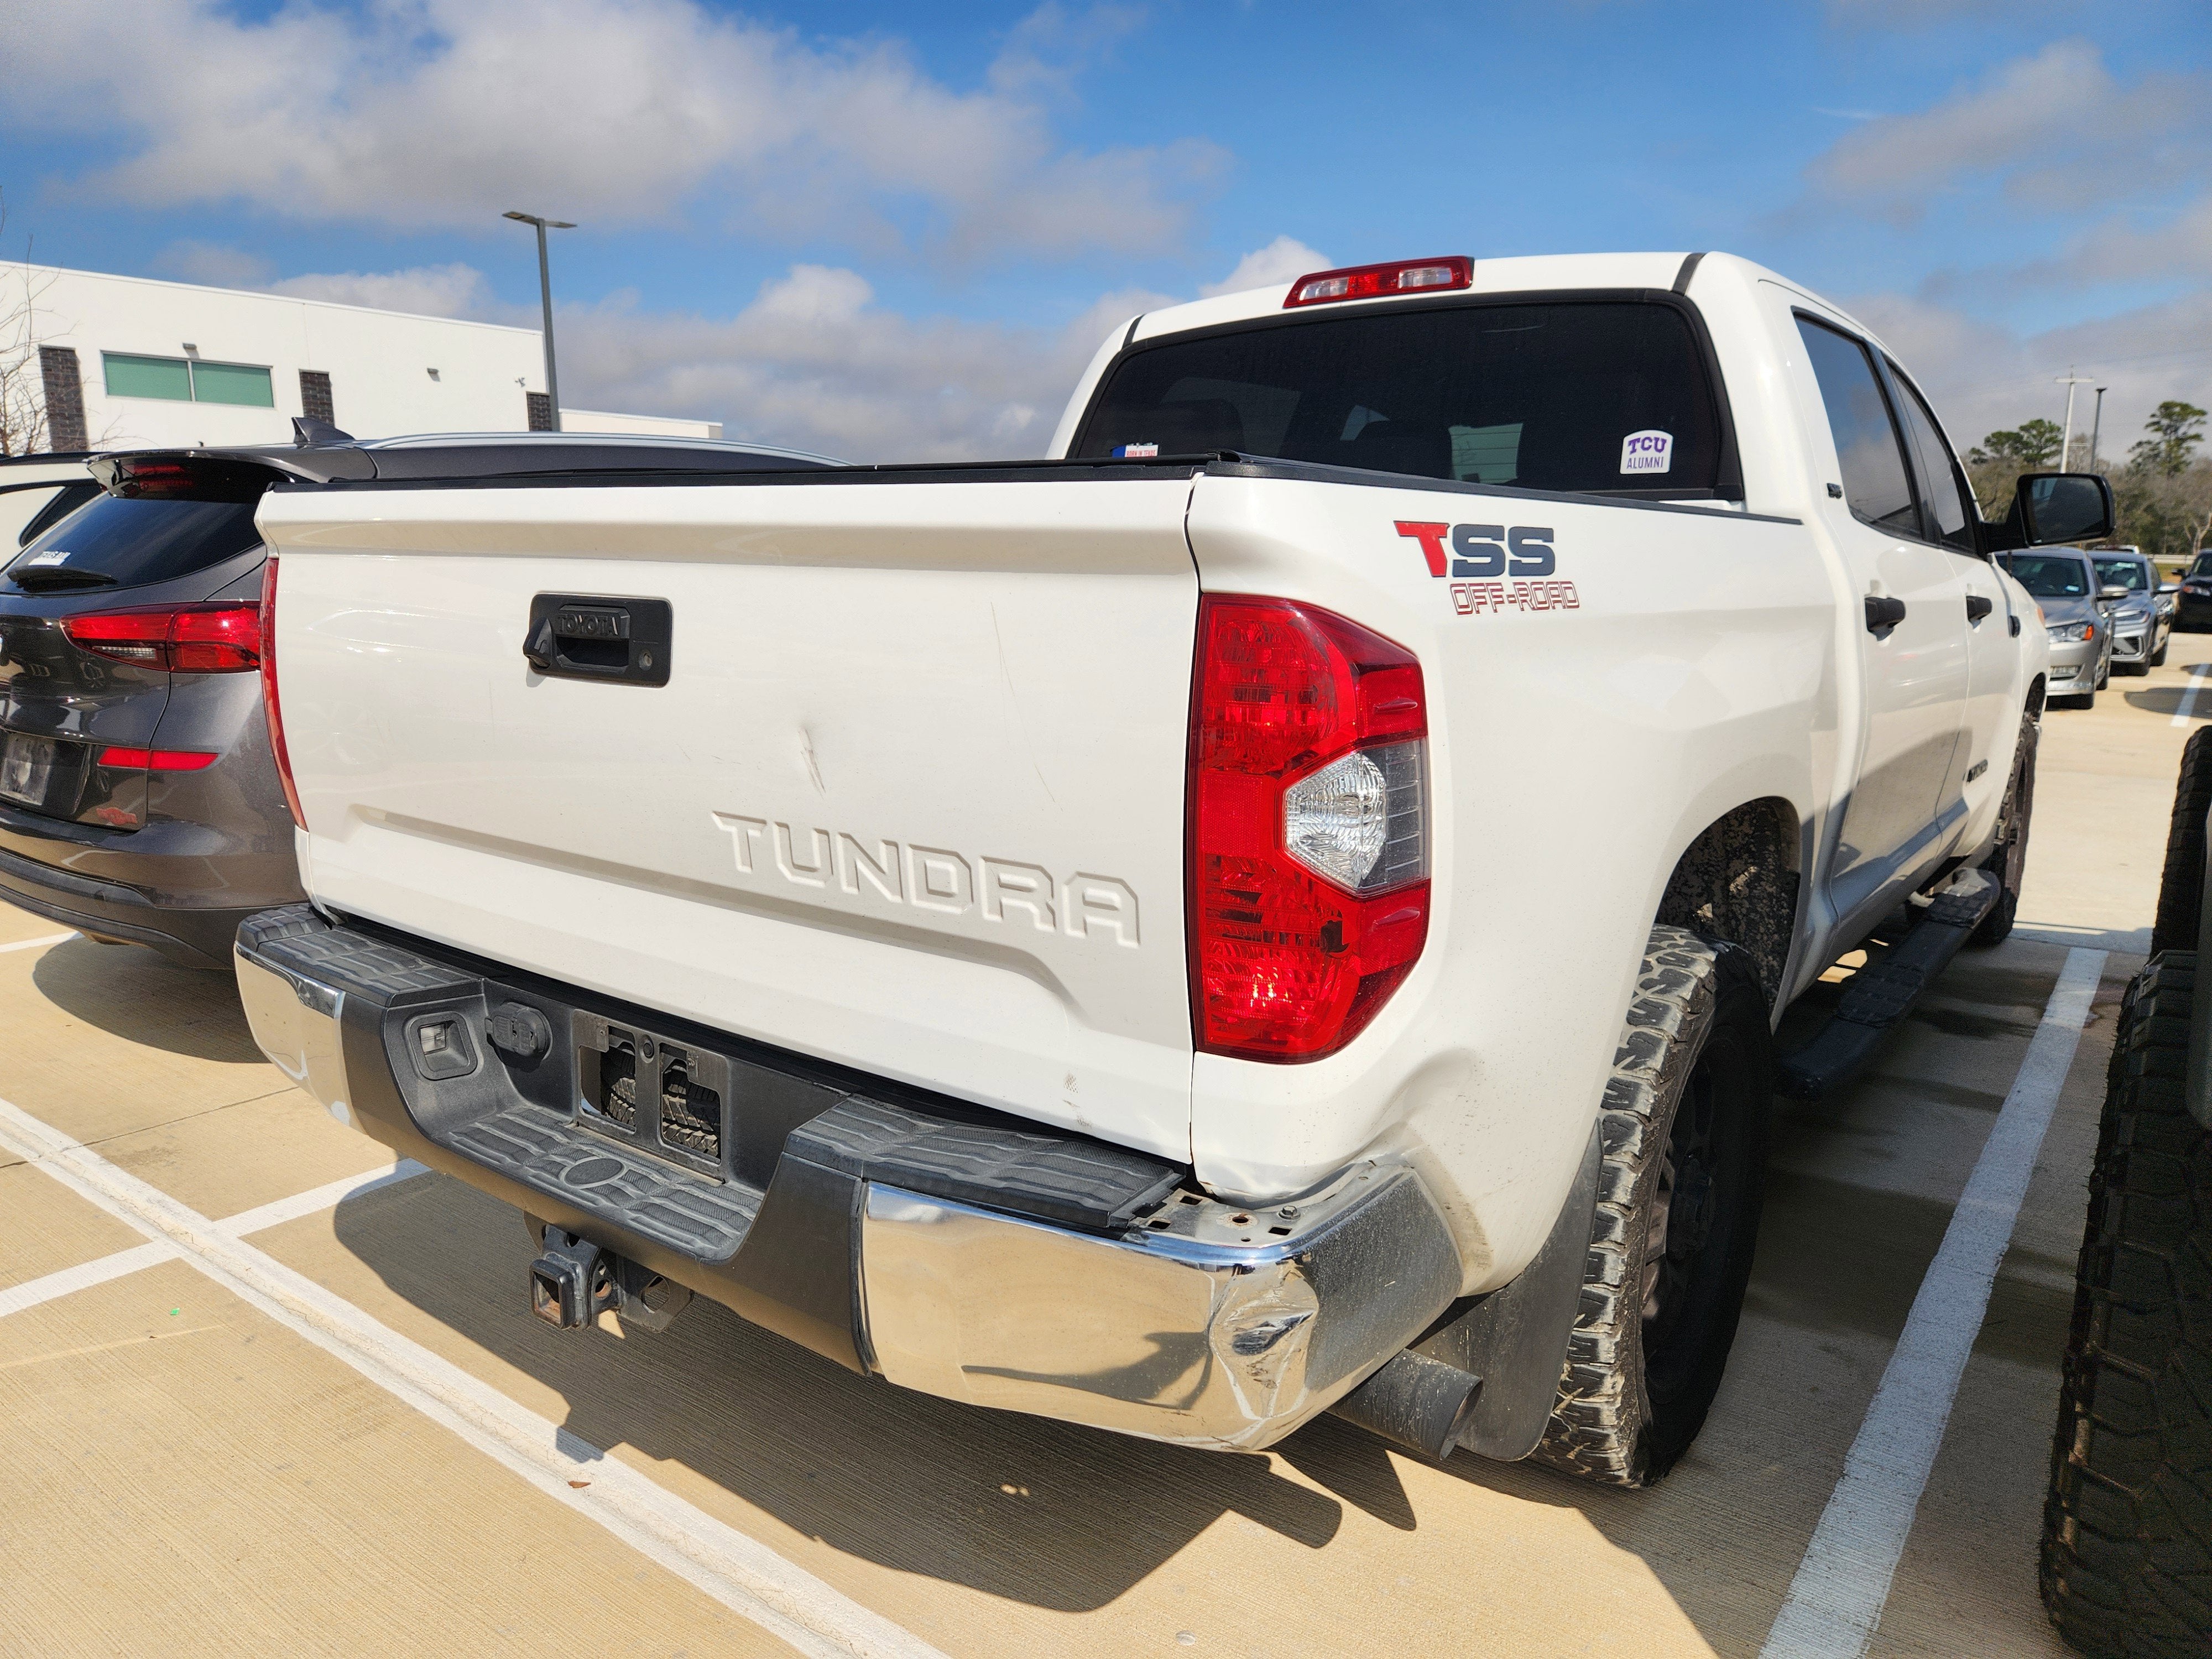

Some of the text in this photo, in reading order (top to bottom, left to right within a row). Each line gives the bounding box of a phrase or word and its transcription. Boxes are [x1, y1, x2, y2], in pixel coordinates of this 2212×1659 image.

[1627, 437, 1667, 455] TCU
[1626, 456, 1664, 469] ALUMNI
[1393, 520, 1556, 578] TSS
[1450, 581, 1580, 615] OFF-ROAD
[556, 613, 619, 636] TOYOTA
[712, 810, 1141, 948] TUNDRA
